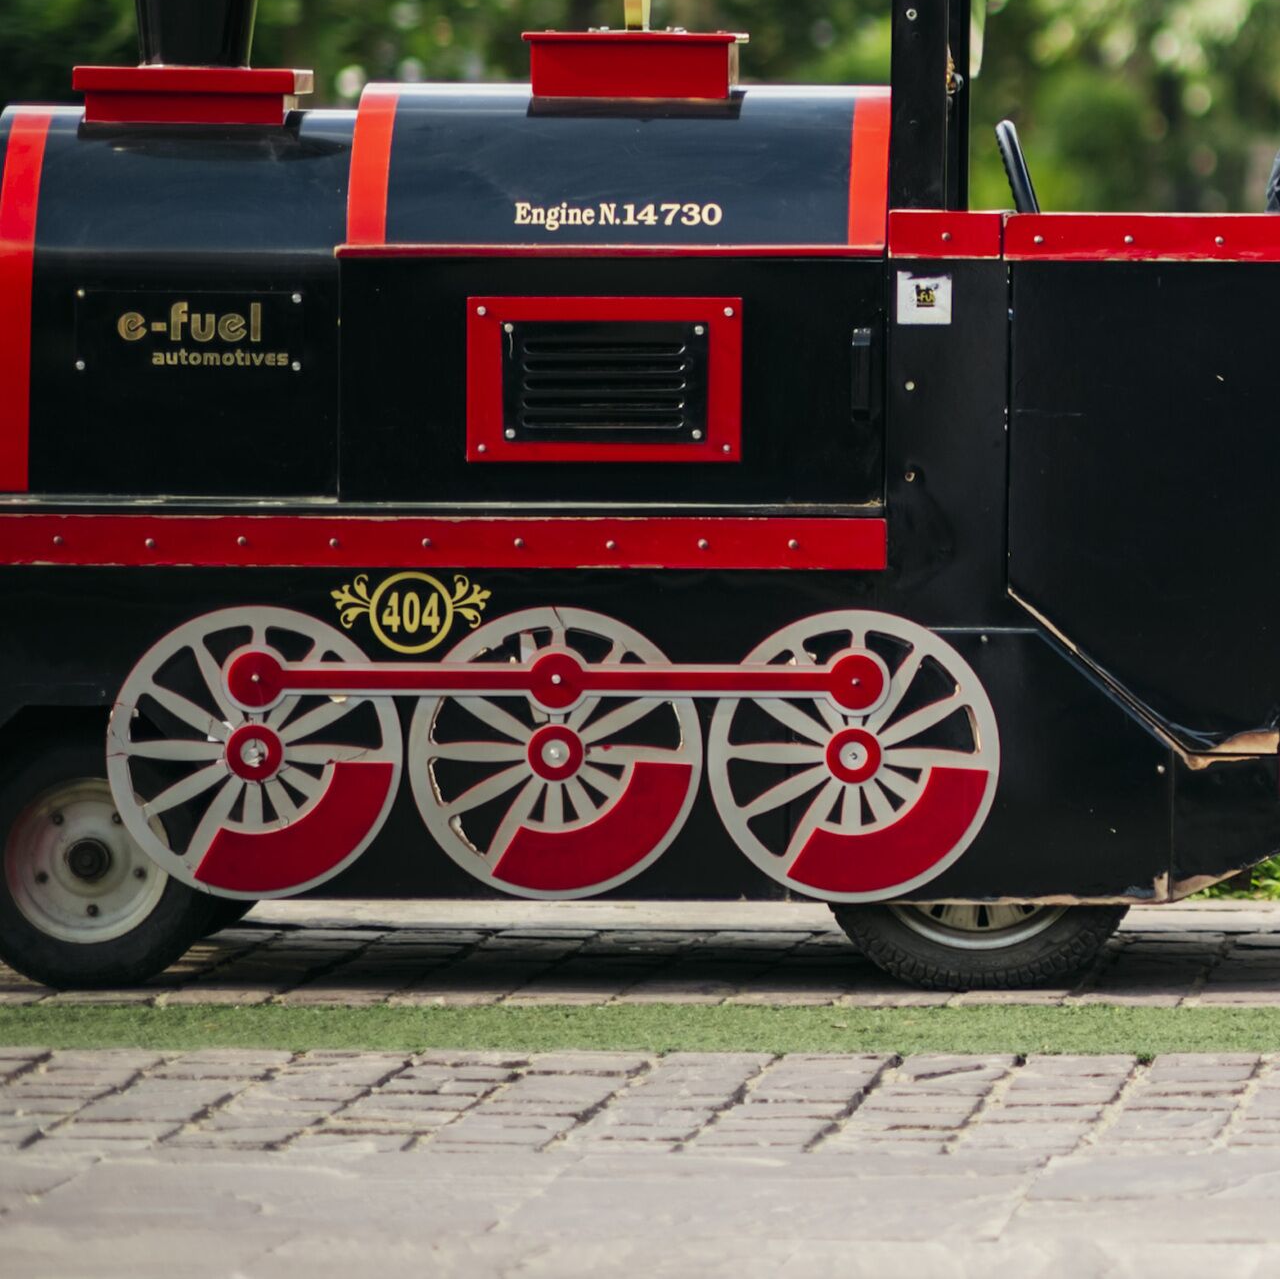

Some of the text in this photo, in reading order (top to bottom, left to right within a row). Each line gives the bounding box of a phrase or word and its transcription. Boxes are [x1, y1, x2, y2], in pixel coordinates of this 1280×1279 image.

[514, 202, 595, 231] Engine
[117, 301, 261, 342] e-fuel
[152, 348, 289, 366] automotives
[382, 591, 440, 633] 404
